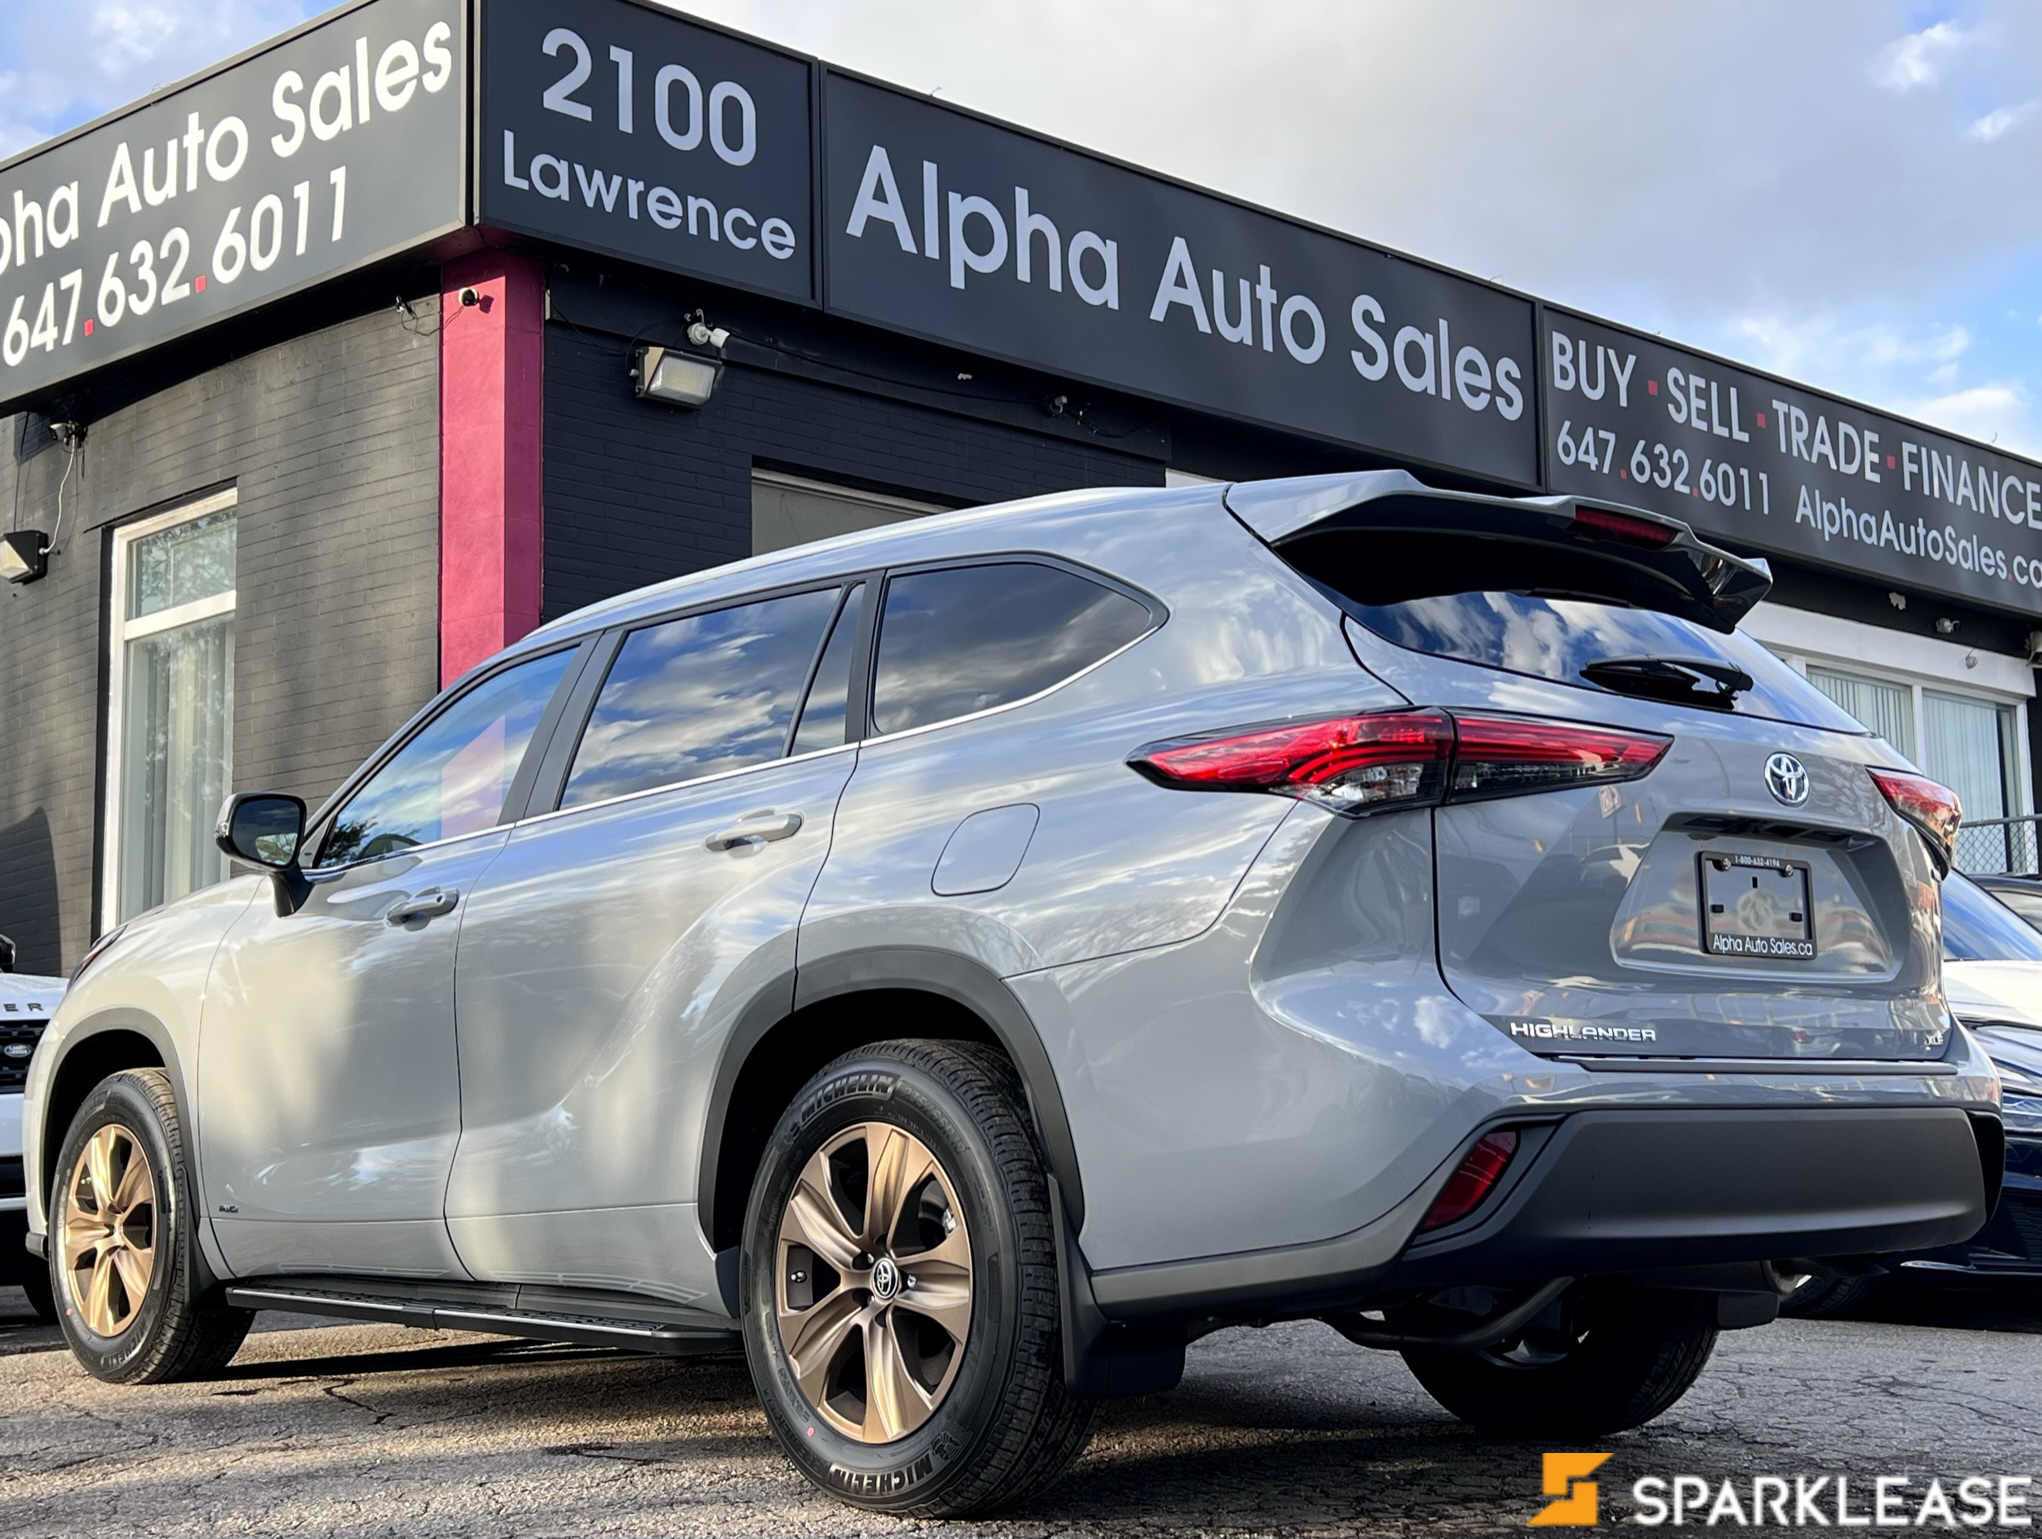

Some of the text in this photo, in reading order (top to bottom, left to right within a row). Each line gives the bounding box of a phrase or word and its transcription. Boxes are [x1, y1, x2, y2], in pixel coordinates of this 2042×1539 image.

[97, 112, 249, 228] Auto
[271, 21, 452, 158] Sales
[542, 28, 756, 166] 2100
[503, 129, 796, 260] Lawrence
[2, 166, 347, 367] 647.632.6011
[846, 145, 1523, 421] Alpha Auto Sales
[1551, 331, 2042, 530] BUY SELL TRADE FINANCE
[1557, 420, 1769, 515] 647.632.6011
[1713, 934, 1742, 953] Alpha
[1744, 937, 1768, 953] Auto
[1510, 1022, 1656, 1041] HIGHLANDER
